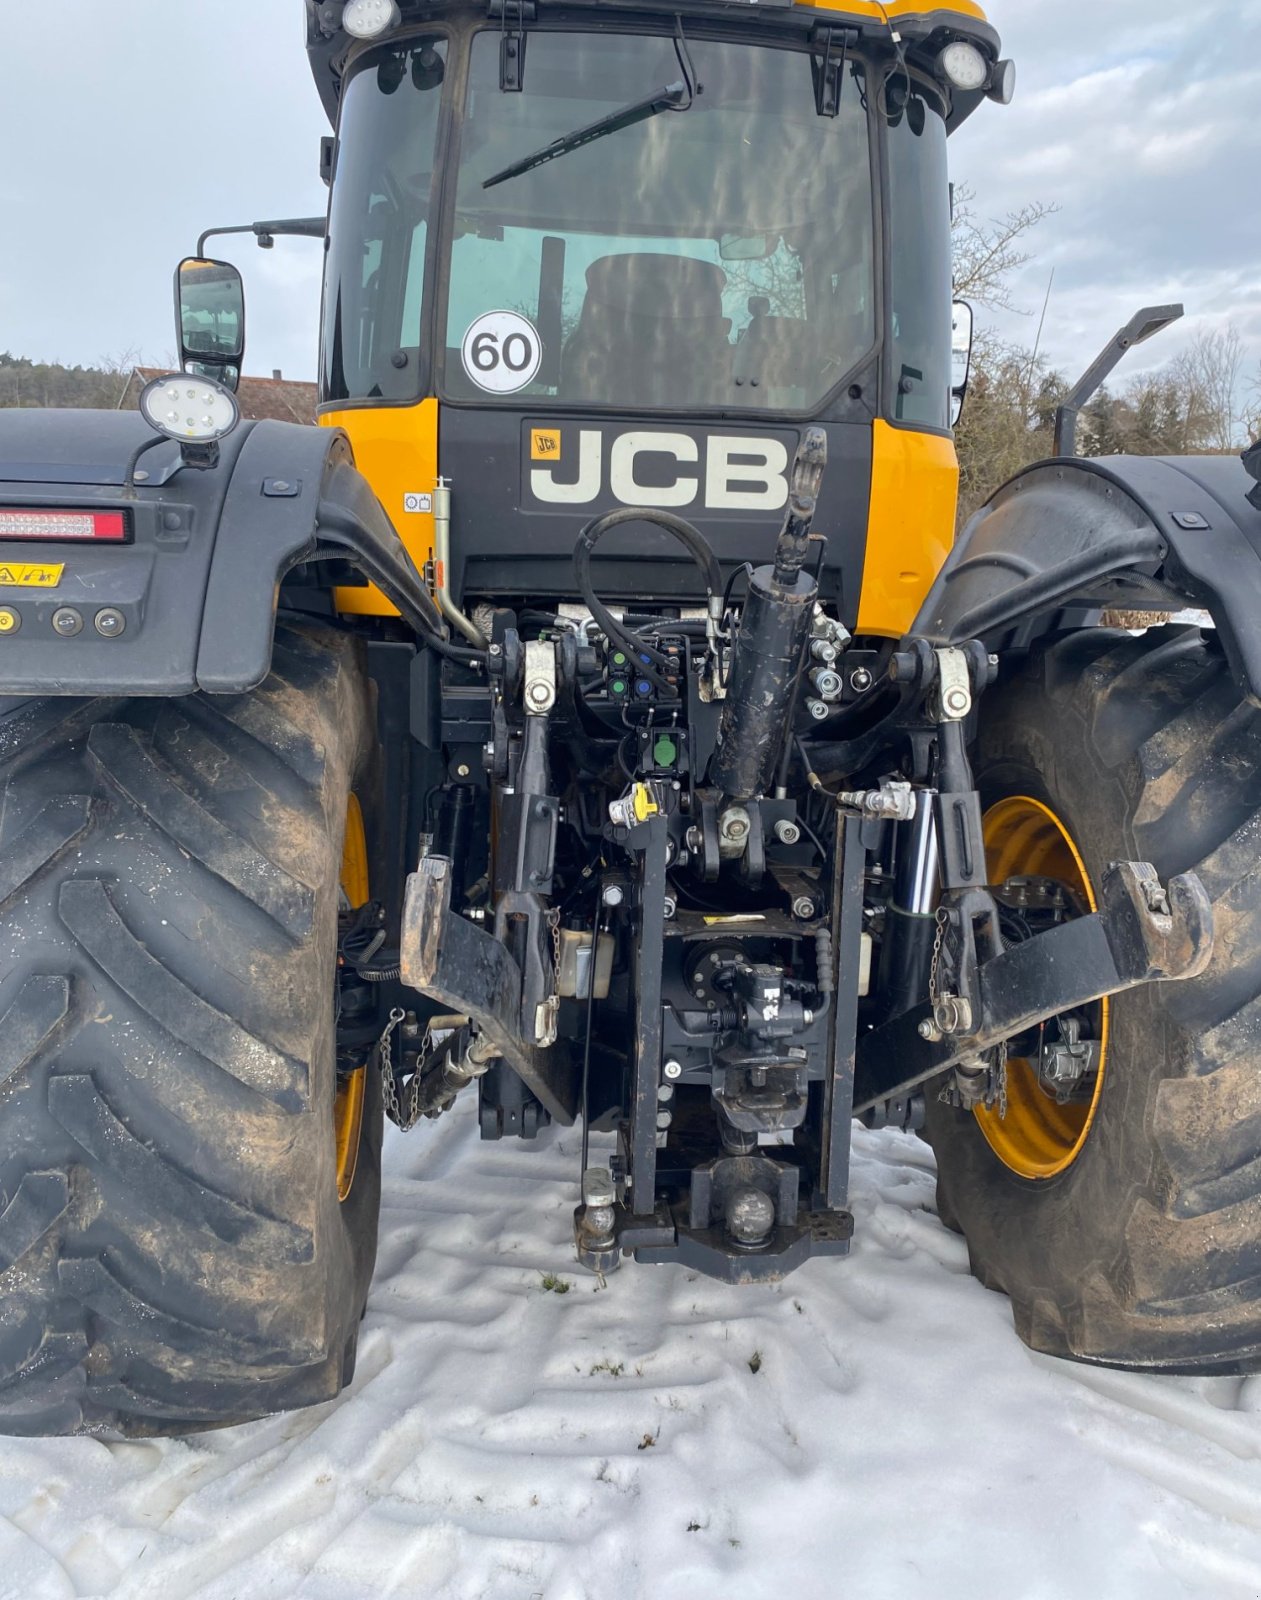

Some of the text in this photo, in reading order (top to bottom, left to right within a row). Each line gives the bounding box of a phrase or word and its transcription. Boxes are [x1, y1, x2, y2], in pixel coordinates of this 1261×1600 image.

[471, 332, 532, 372] 60
[538, 437, 556, 451] JCB
[531, 430, 789, 510] JCB
